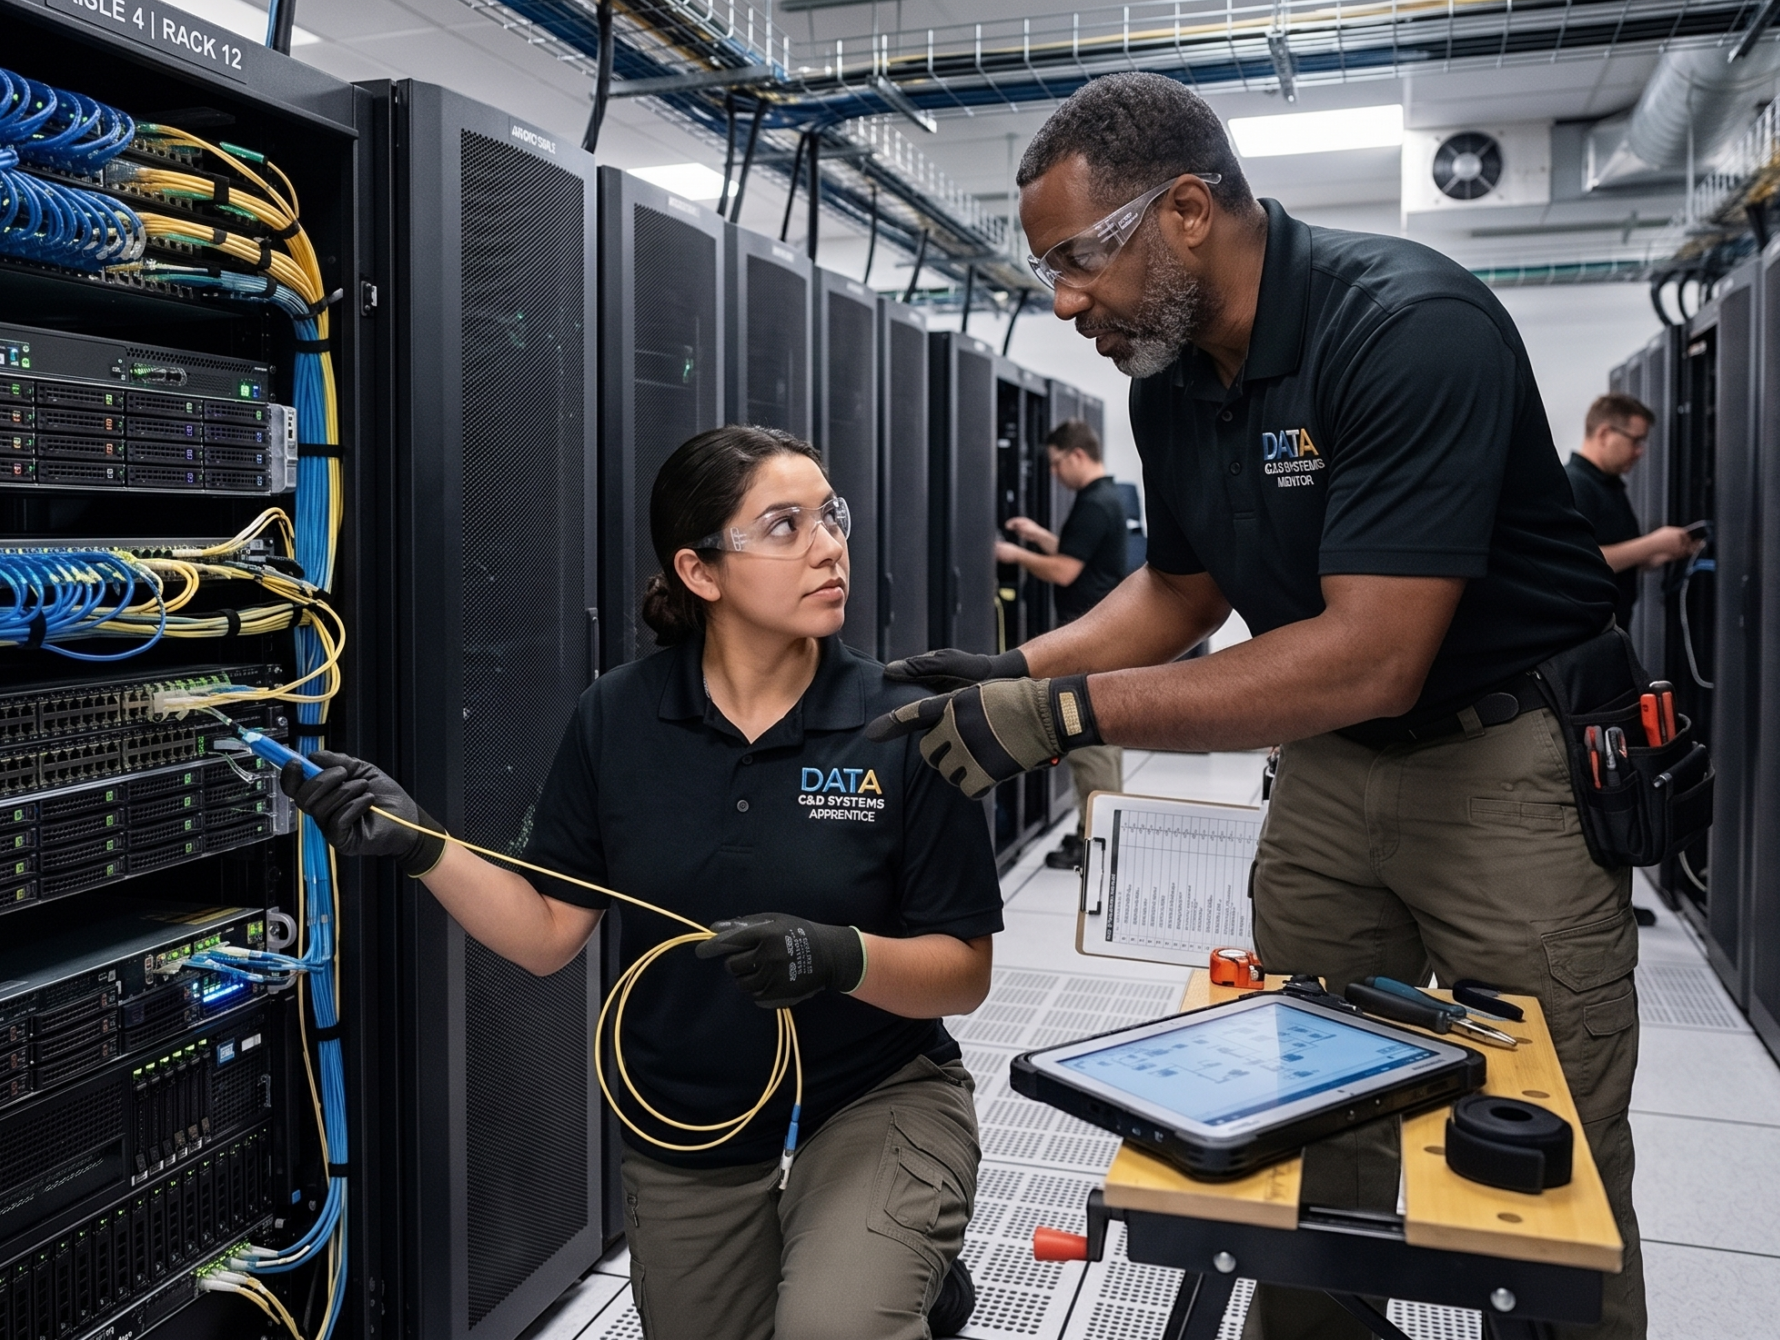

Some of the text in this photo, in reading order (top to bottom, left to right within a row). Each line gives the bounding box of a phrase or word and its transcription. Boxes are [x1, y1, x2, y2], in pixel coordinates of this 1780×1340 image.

[73, 0, 126, 23] SLE
[132, 7, 145, 30] 4
[162, 18, 217, 60] RACK
[221, 44, 242, 70] 12
[1262, 428, 1319, 460] DATA
[801, 767, 883, 795] DATA
[798, 794, 885, 809] C&D SYSTEMS
[809, 808, 876, 822] APPRENTICE
